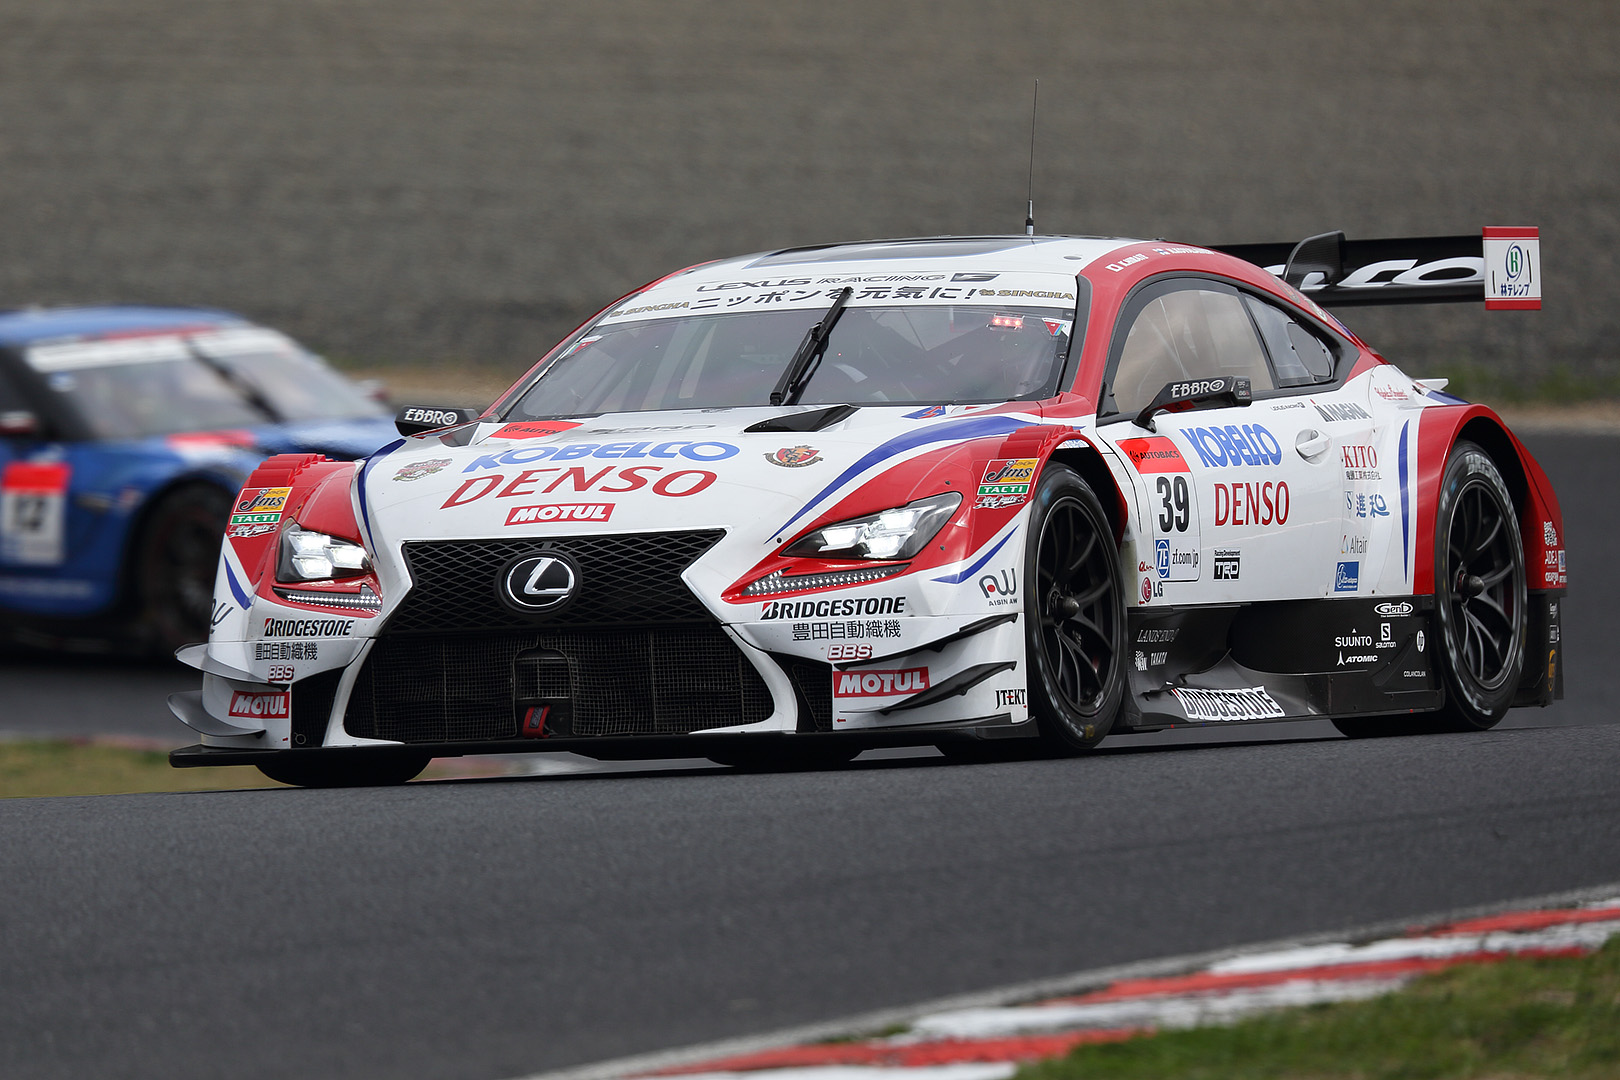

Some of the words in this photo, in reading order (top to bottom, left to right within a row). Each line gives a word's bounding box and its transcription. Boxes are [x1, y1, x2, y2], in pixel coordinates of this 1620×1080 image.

[696, 277, 812, 292] LEXUS
[816, 274, 946, 285] RACING
[995, 289, 1076, 300] SINGHA
[623, 302, 690, 317] SINGHA
[1171, 379, 1225, 398] EBBRO
[404, 408, 458, 426] EBBRO
[1139, 450, 1180, 460] AUTOBACS
[1180, 423, 1283, 468] KOBELCO
[462, 440, 740, 473] KOBELCO
[1341, 445, 1377, 468] KITO
[440, 465, 718, 510] DENSO
[984, 485, 1024, 494] TACTI
[509, 503, 607, 523] MOTUL
[1156, 475, 1190, 533] 39
[1214, 481, 1290, 527] DENSO
[236, 514, 276, 523] TACTI
[1152, 581, 1164, 598] LG
[760, 597, 906, 620] BRIDGESTONE
[264, 618, 355, 637] BRIDGESTONE
[792, 620, 901, 642] 豊田自動織機
[256, 642, 318, 661] 豊田自動織機
[1335, 636, 1373, 648] SUUNTO
[827, 644, 873, 660] BBS
[1346, 654, 1379, 664] ATOMIC
[267, 664, 295, 682] BBS
[838, 670, 926, 695] MOTUL
[232, 694, 287, 716] MOTUL
[995, 689, 1026, 710] JTEKT
[1172, 685, 1285, 721] BRIDGESTONE
